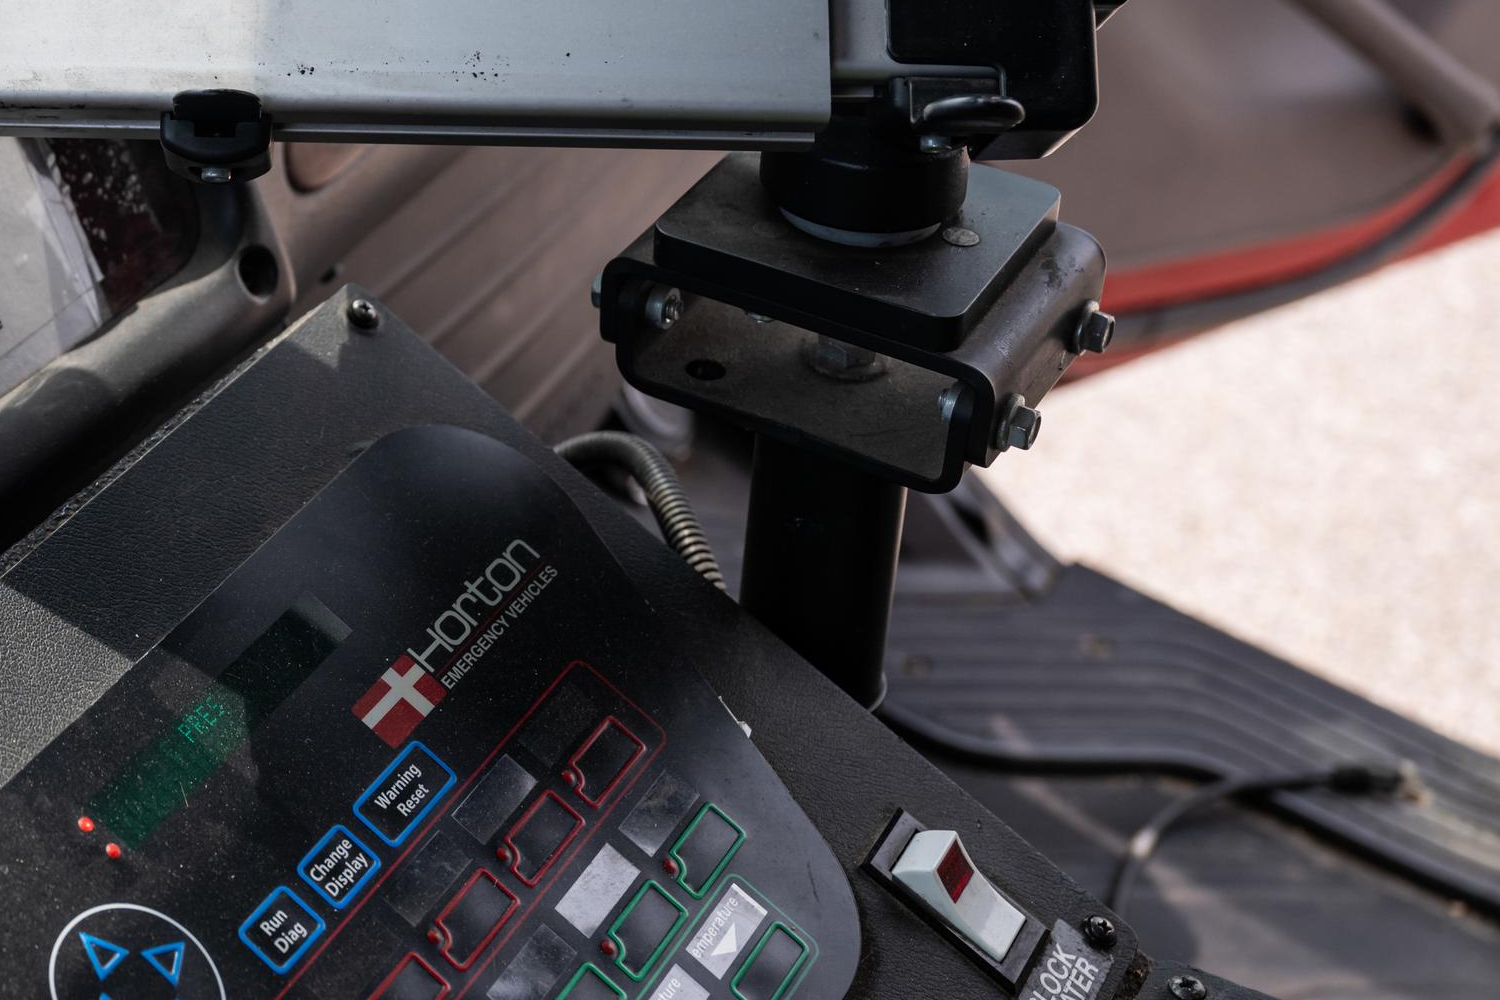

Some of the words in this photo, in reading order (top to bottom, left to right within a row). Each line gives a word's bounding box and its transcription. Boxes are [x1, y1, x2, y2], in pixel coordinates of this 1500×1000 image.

[407, 538, 541, 673] Horton
[440, 617, 509, 690] EMERGENCY
[504, 565, 558, 622] VEHICLES
[373, 763, 423, 811] Warning
[396, 783, 430, 818] Reset
[308, 837, 353, 883] Change
[324, 852, 369, 898] Display
[259, 909, 288, 937] Run
[273, 921, 309, 955] Diag
[1029, 943, 1077, 1000] LOCK
